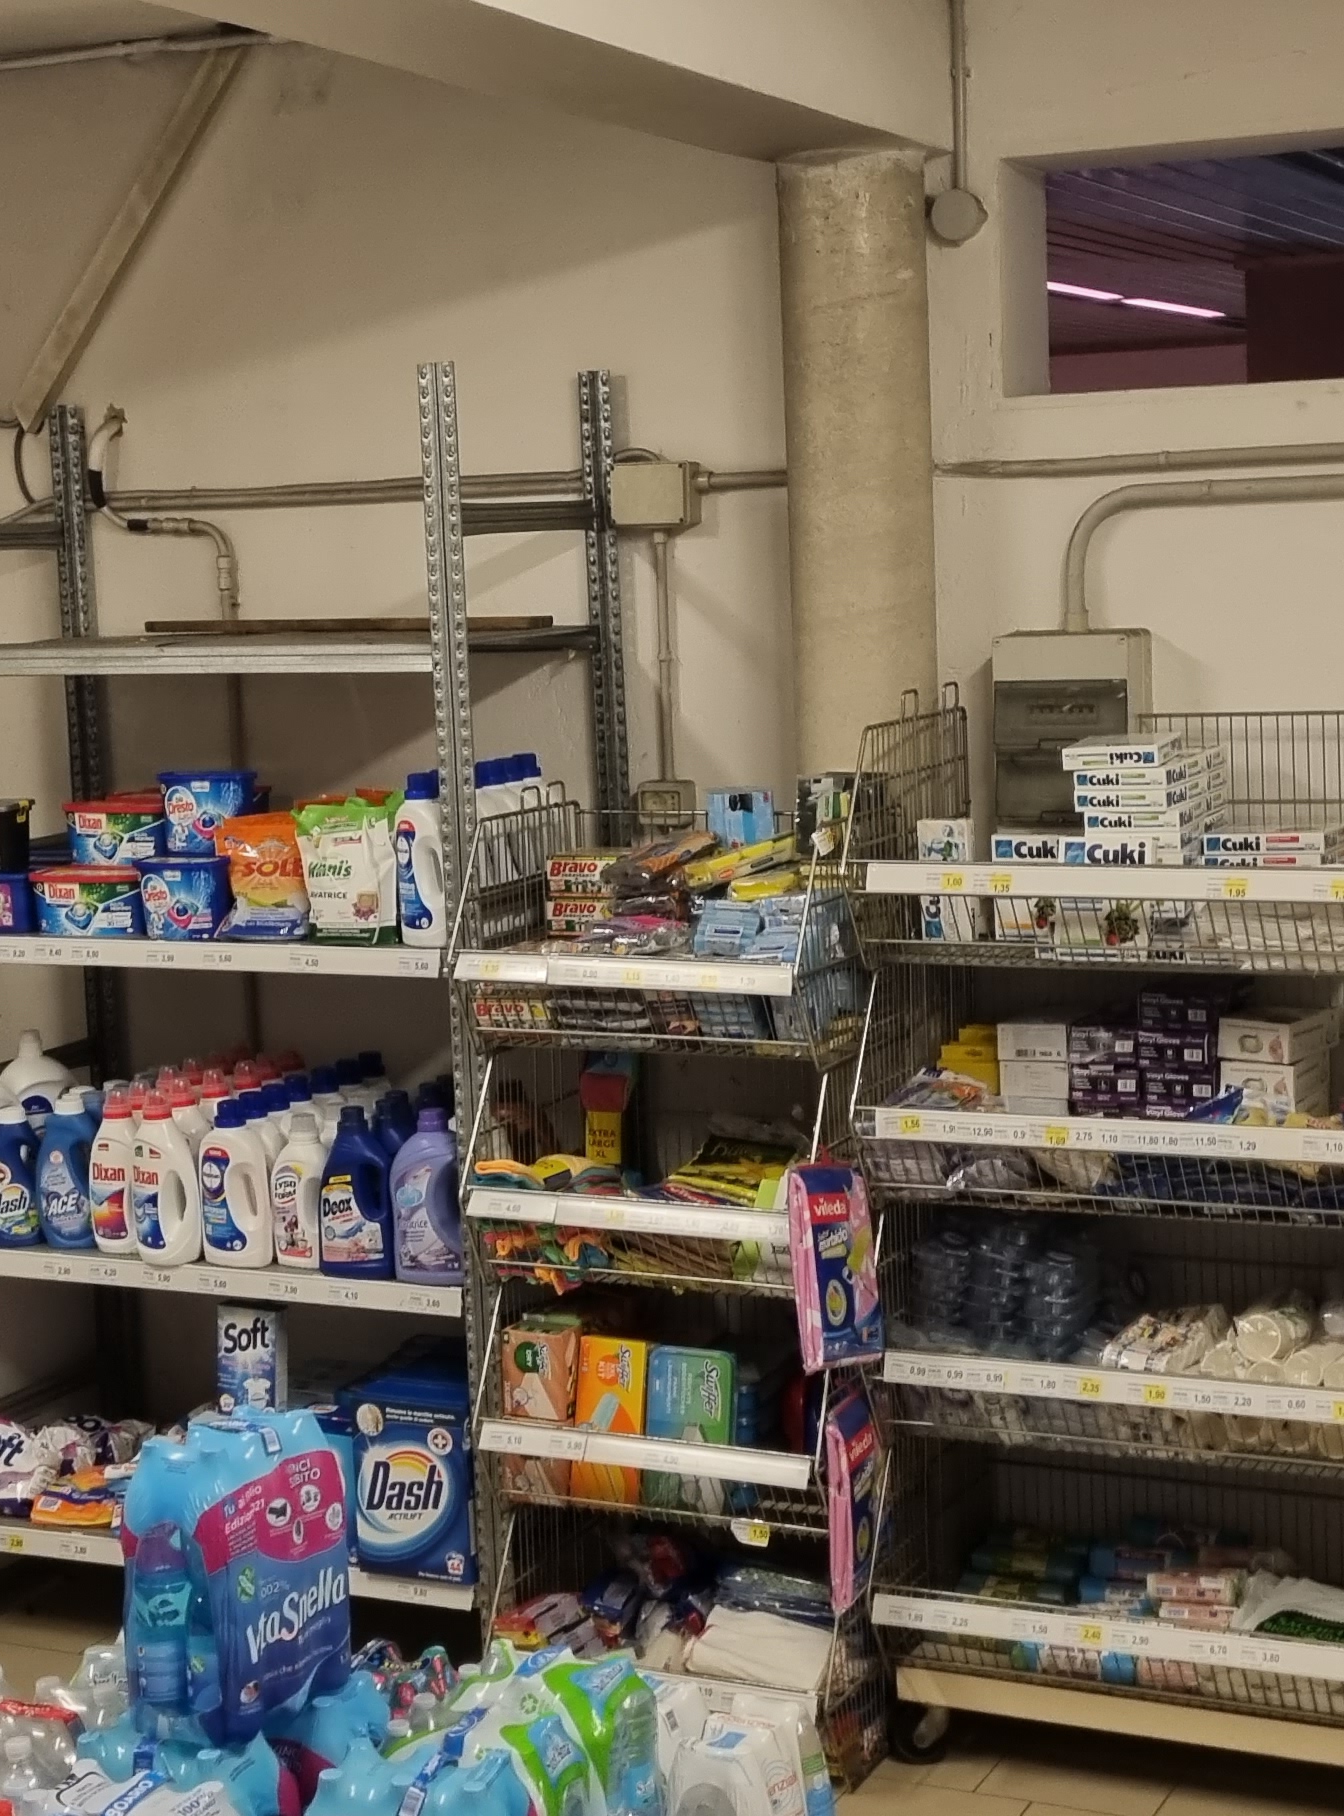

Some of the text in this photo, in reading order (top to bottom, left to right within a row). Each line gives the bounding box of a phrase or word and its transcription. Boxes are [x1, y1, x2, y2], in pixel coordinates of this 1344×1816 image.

[1109, 751, 1142, 764] Cuki
[1088, 773, 1120, 786] Cuki
[1088, 795, 1120, 808] Cuki
[77, 813, 103, 830] Dixan
[1099, 814, 1132, 828] Cuki
[1013, 838, 1056, 861] Cuk
[1221, 836, 1261, 851] Cuki
[1086, 841, 1147, 865] Cuki
[550, 859, 599, 878] Bravo
[946, 876, 962, 888] 1,00
[992, 882, 1011, 894] 1,35
[47, 884, 76, 900] Dixan
[310, 891, 348, 900] AVATRICE
[1227, 887, 1246, 899] 1,95
[552, 901, 597, 919] Bravo
[476, 1002, 525, 1018] Bravo
[1138, 1036, 1181, 1045] Vinyl Gloves
[1146, 1072, 1189, 1081] Vinyl Gloves
[1164, 1110, 1186, 1118] Glove
[588, 1128, 617, 1139] EXTRA
[1075, 1131, 1093, 1142] 2,75
[1101, 1133, 1118, 1144] 1,10
[588, 1138, 616, 1148] LARGE
[1195, 1137, 1217, 1147] 11,50
[1325, 1142, 1343, 1153] 1,10
[595, 1149, 607, 1159] XL
[92, 1162, 125, 1182] Dixan
[133, 1165, 159, 1185] Dixan
[48, 1194, 80, 1216] ACE
[323, 1197, 353, 1218] Deox
[813, 1197, 847, 1217] vileda
[223, 1316, 270, 1356] Soft
[619, 1342, 632, 1392] Swiffer
[909, 1366, 926, 1377] 0,99
[946, 1370, 963, 1379] 0,99
[986, 1373, 1003, 1383] 0,99
[698, 1358, 720, 1419] Swiffer
[1082, 1382, 1100, 1393] 2,35
[1148, 1389, 1165, 1400] 1,90
[1194, 1393, 1211, 1404] 1,50
[1233, 1395, 1252, 1407] 2,20
[1287, 1399, 1306, 1409] 0,60
[365, 1460, 444, 1511] Dash
[387, 1512, 424, 1521] ACTILIFT
[753, 1527, 768, 1540] 1,50
[1031, 1624, 1048, 1636] 1,50
[1082, 1628, 1101, 1640] 2,40
[1131, 1634, 1149, 1647] 2,90
[1209, 1643, 1228, 1656] 6,70
[1261, 1652, 1280, 1664] 3,80
